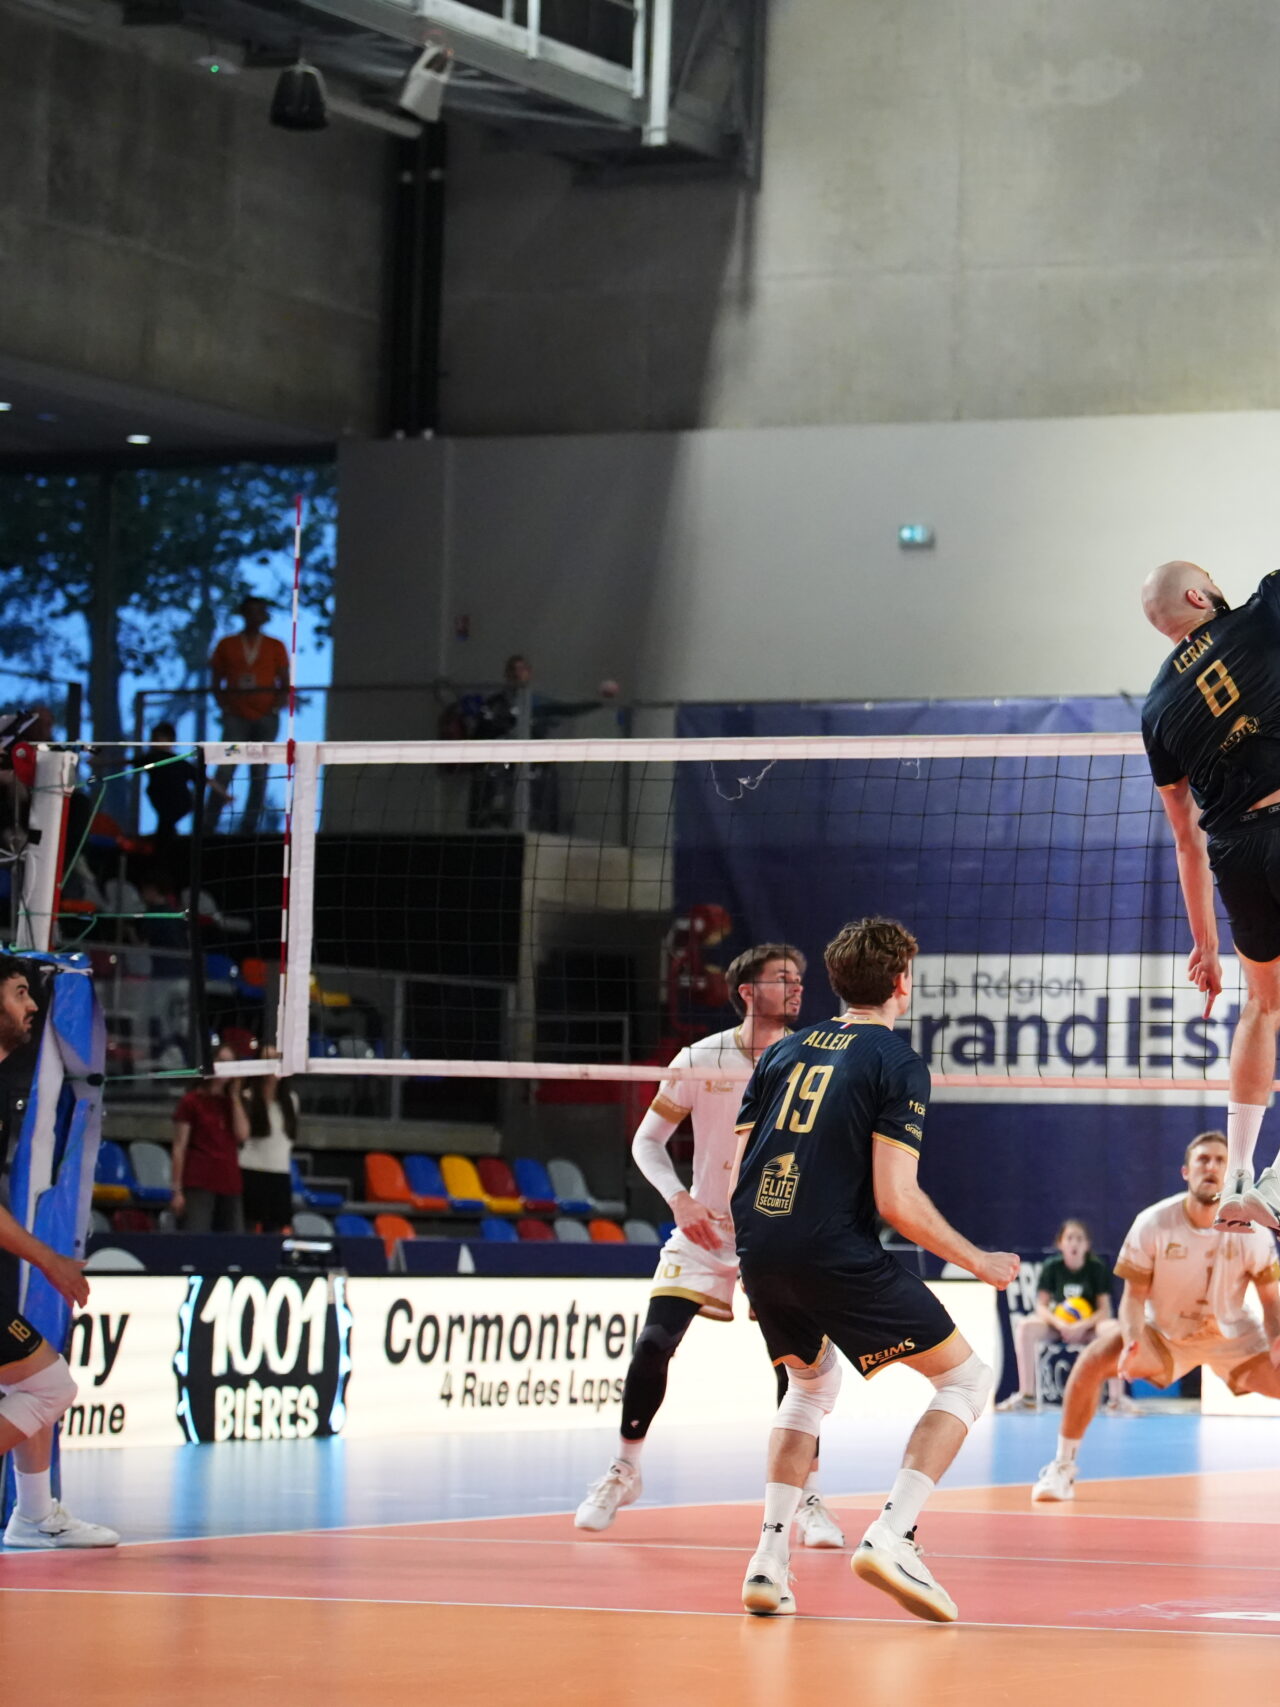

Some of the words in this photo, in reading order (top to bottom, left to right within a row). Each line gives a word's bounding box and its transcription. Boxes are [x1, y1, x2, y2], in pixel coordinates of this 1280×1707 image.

[1173, 631, 1214, 674] LERAY
[1196, 659, 1240, 718] 8
[920, 972, 958, 998] La
[971, 970, 1086, 1003] Région
[802, 1030, 858, 1051] ALLEIX
[918, 996, 1109, 1067] rand
[775, 1062, 834, 1134] 19
[201, 1275, 329, 1377] 1001
[384, 1298, 639, 1365] Cormontre
[858, 1337, 916, 1373] REIMS
[214, 1378, 320, 1442] BIÈRES
[440, 1371, 453, 1408] 4
[461, 1371, 510, 1408] Rue
[517, 1368, 560, 1408] des
